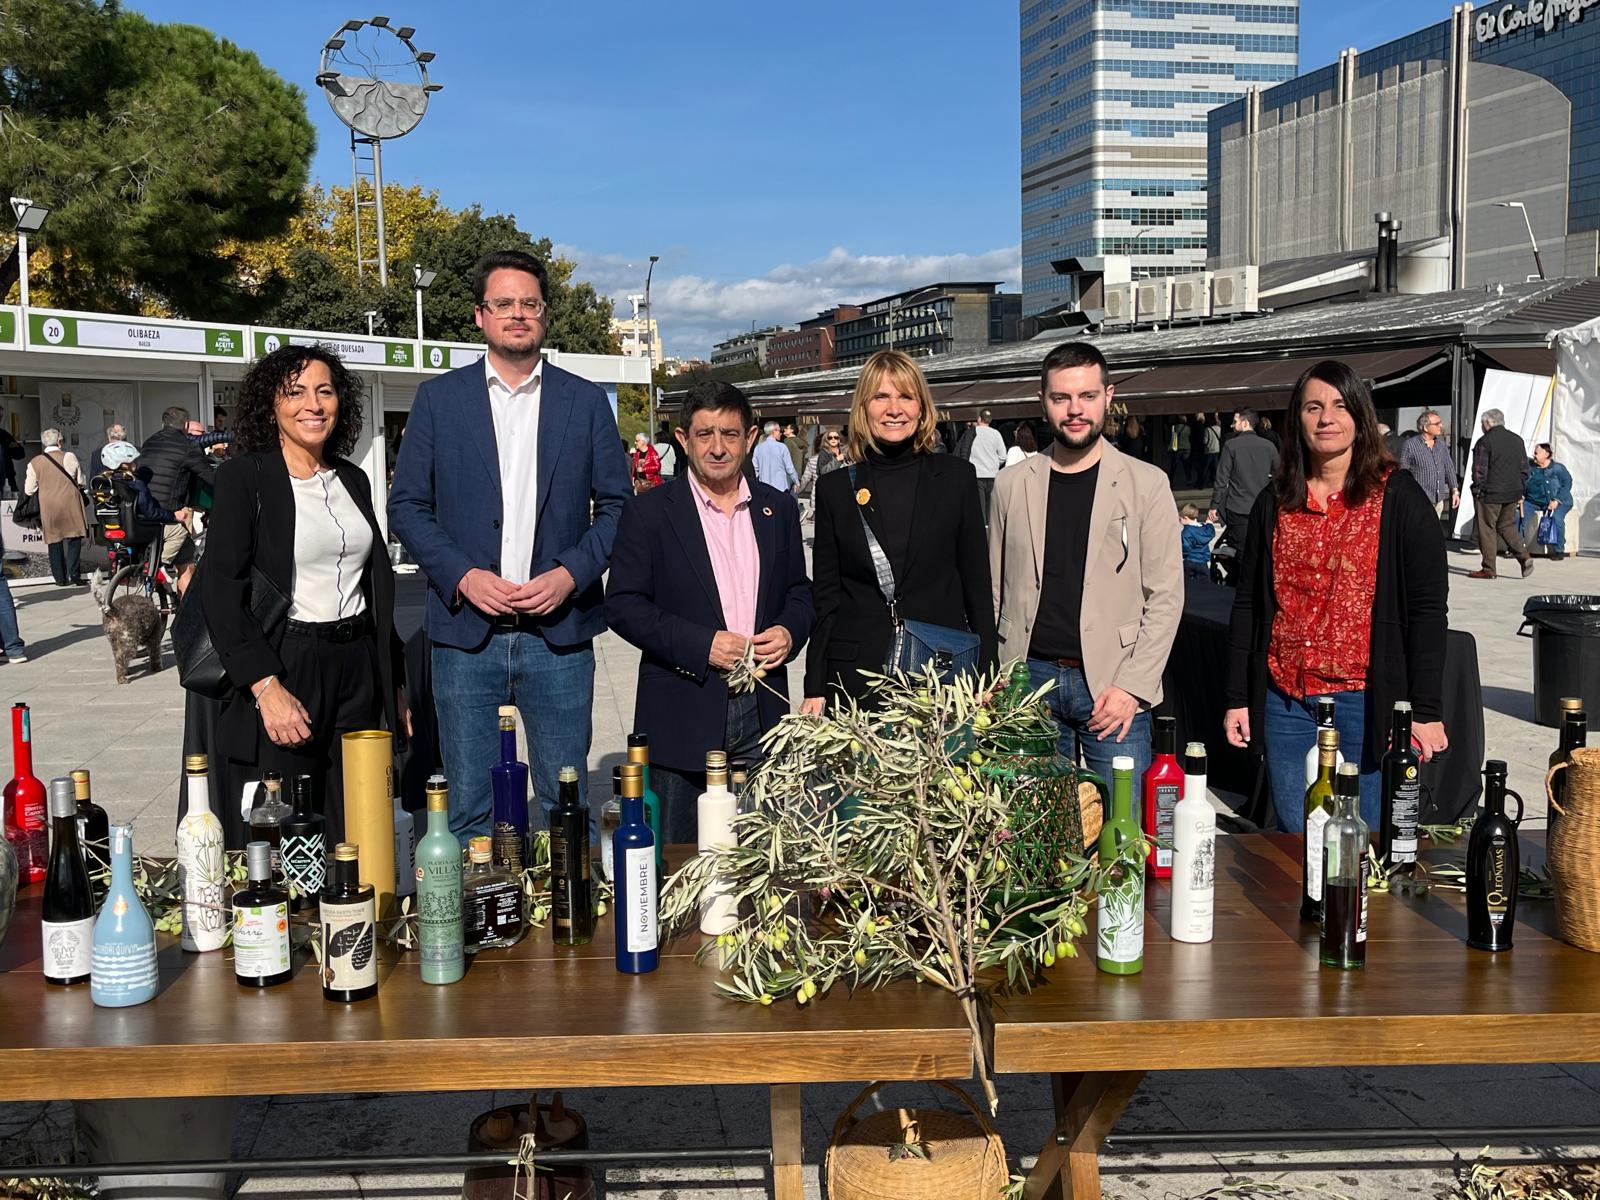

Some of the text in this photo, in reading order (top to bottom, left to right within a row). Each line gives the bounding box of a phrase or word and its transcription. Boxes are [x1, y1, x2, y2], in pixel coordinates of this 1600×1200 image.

[1476, 12, 1496, 42] El
[1497, 0, 1543, 35] Corte
[48, 326, 59, 337] 20
[127, 328, 160, 339] OLIBAEZA
[268, 342, 276, 351] 21
[340, 344, 365, 353] QUESADA
[433, 354, 439, 362] 22
[22, 534, 43, 543] PRIM
[428, 863, 461, 875] VILLAS
[639, 863, 648, 933] NOVIEMBRE
[51, 946, 76, 954] OLIVO
